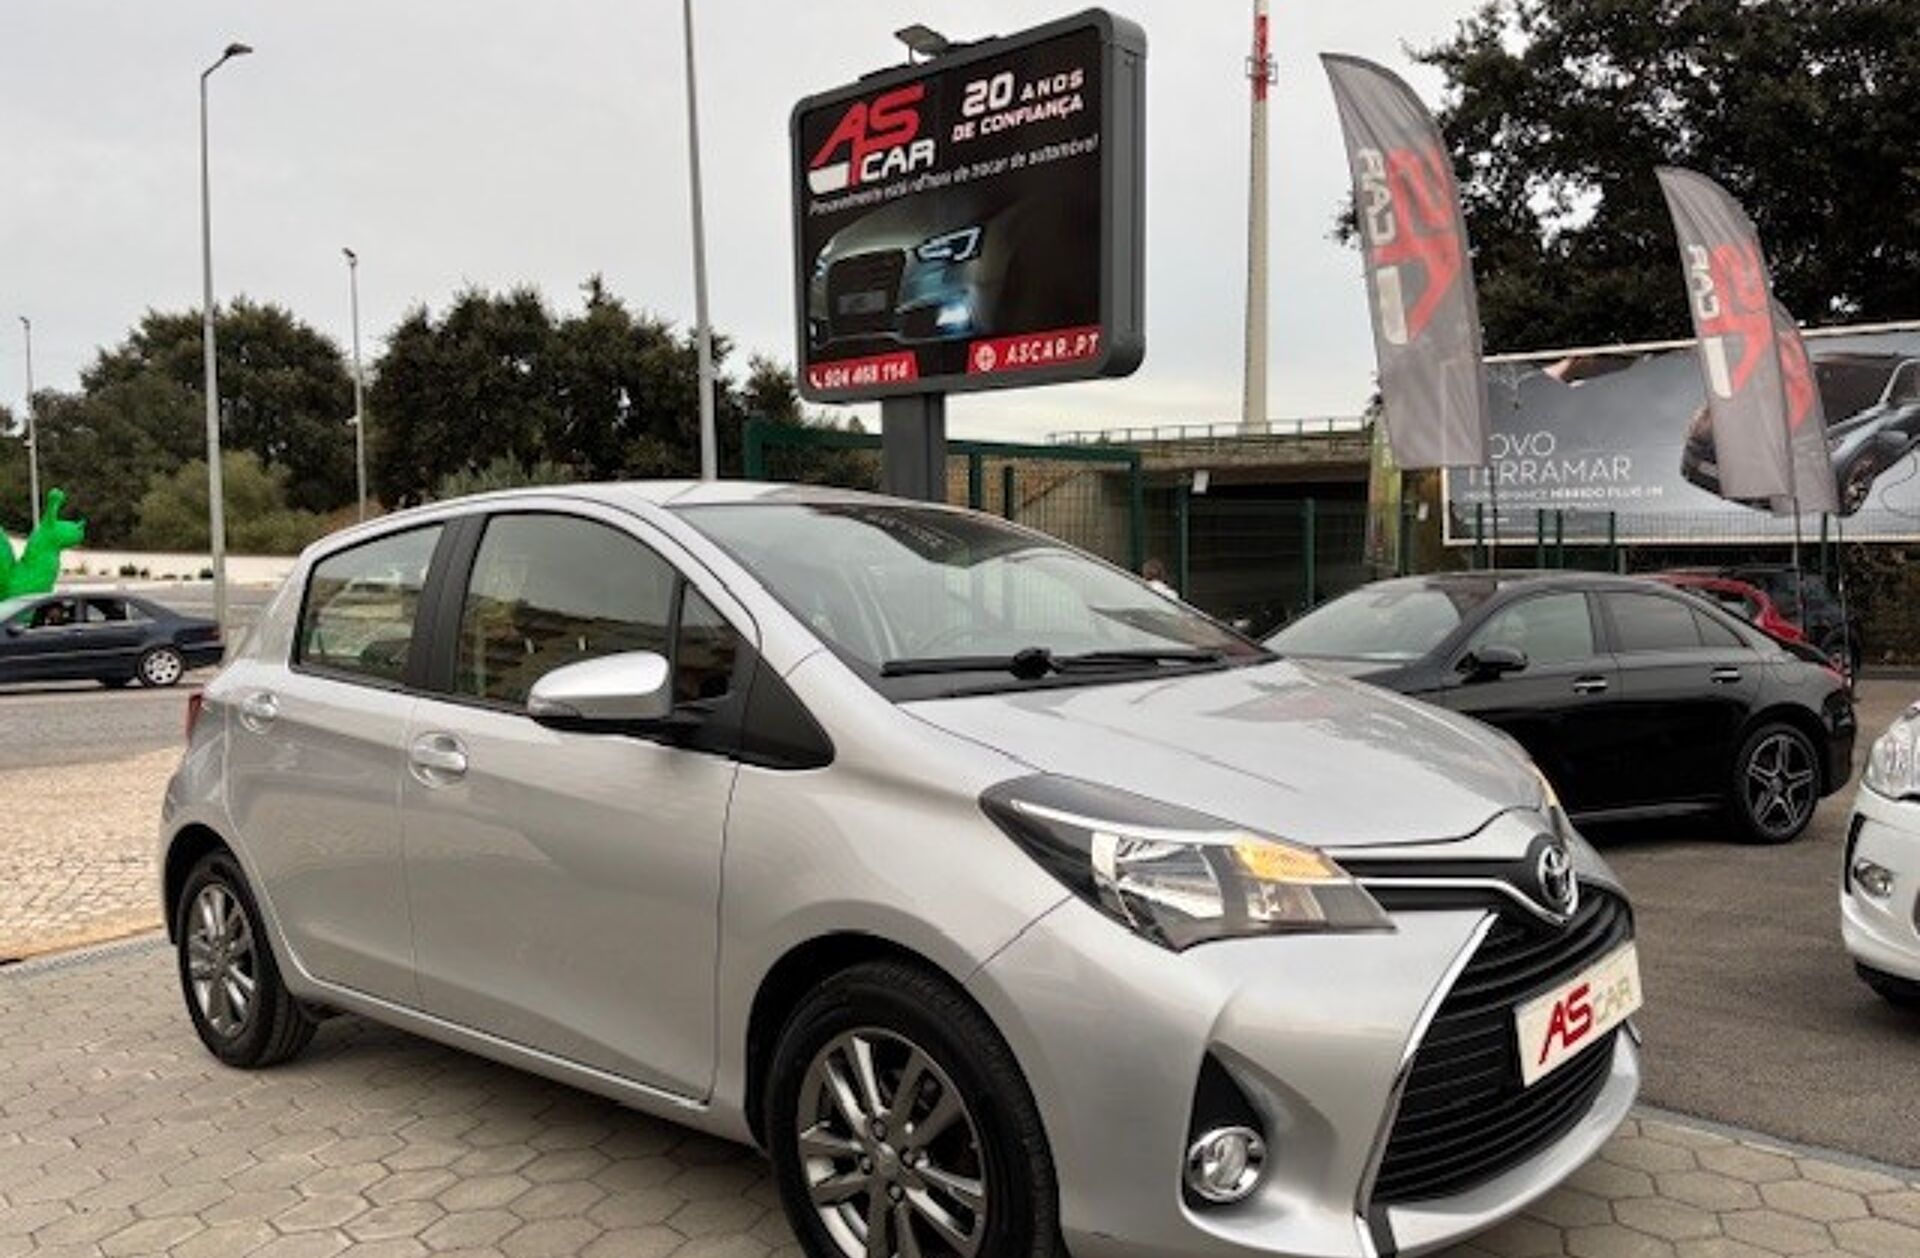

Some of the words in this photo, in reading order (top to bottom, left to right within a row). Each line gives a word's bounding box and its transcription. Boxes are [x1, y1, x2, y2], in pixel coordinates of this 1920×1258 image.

[962, 71, 1014, 117] 20
[1021, 68, 1084, 102] ANOS
[809, 82, 926, 187] AS
[952, 121, 976, 142] DE
[980, 94, 1084, 134] CONFIANÇA
[861, 139, 935, 182] CAR
[1358, 148, 1396, 246] CAR
[1006, 332, 1100, 365] ASCAR.PT
[1488, 430, 1555, 459] OVO
[1538, 981, 1593, 1065] AS
